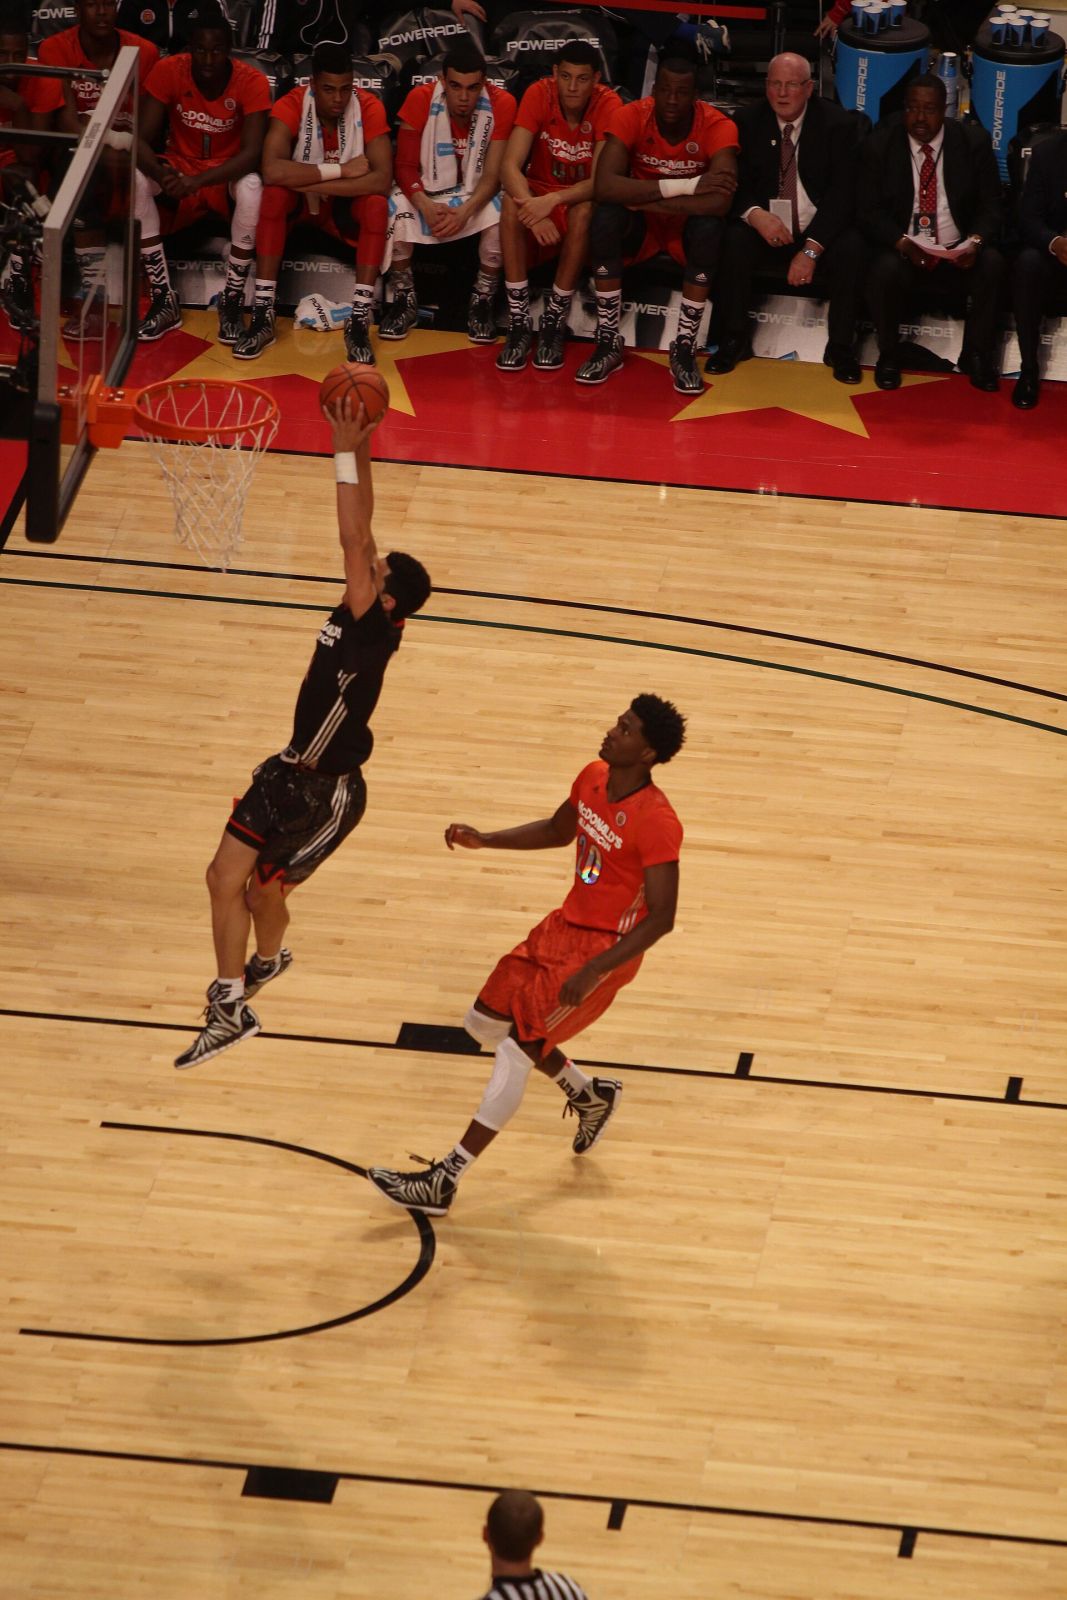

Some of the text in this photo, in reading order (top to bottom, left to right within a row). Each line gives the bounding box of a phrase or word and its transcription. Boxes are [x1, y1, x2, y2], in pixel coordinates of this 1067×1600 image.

[378, 23, 467, 50] POWERADE
[506, 38, 600, 52] POWERE
[992, 70, 1006, 150] POWERADE
